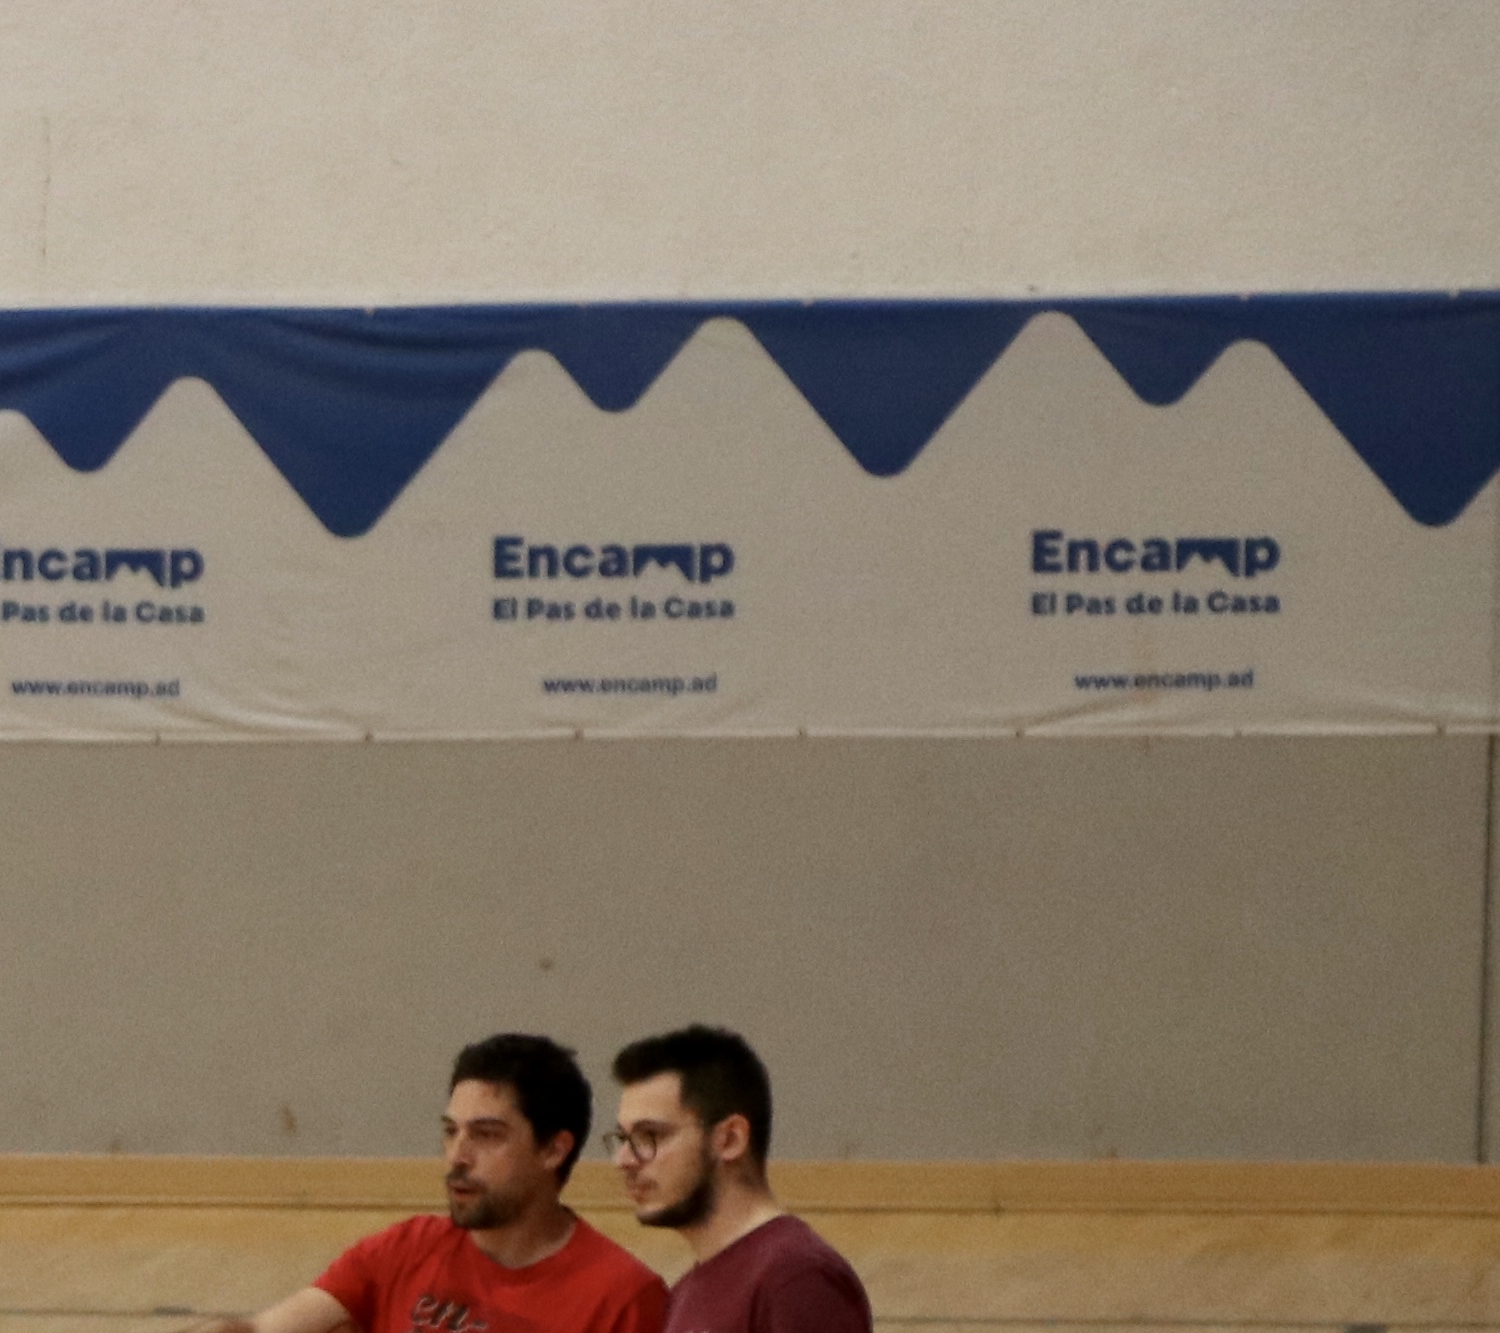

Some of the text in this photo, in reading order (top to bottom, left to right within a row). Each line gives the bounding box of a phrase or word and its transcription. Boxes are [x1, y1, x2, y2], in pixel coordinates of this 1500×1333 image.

[493, 536, 734, 583] Encamp
[1032, 530, 1281, 578] Encamp
[0, 601, 50, 623] Pas
[57, 602, 94, 623] de
[102, 602, 127, 623] la
[134, 601, 204, 624] Casa
[492, 597, 735, 620] El Pas de la Casa
[1031, 591, 1281, 615] El Pas de la Casa
[11, 680, 180, 698] www.encamp.ad
[542, 675, 718, 696] www.encamp.ad
[1074, 669, 1255, 691] www.encamp.ad
